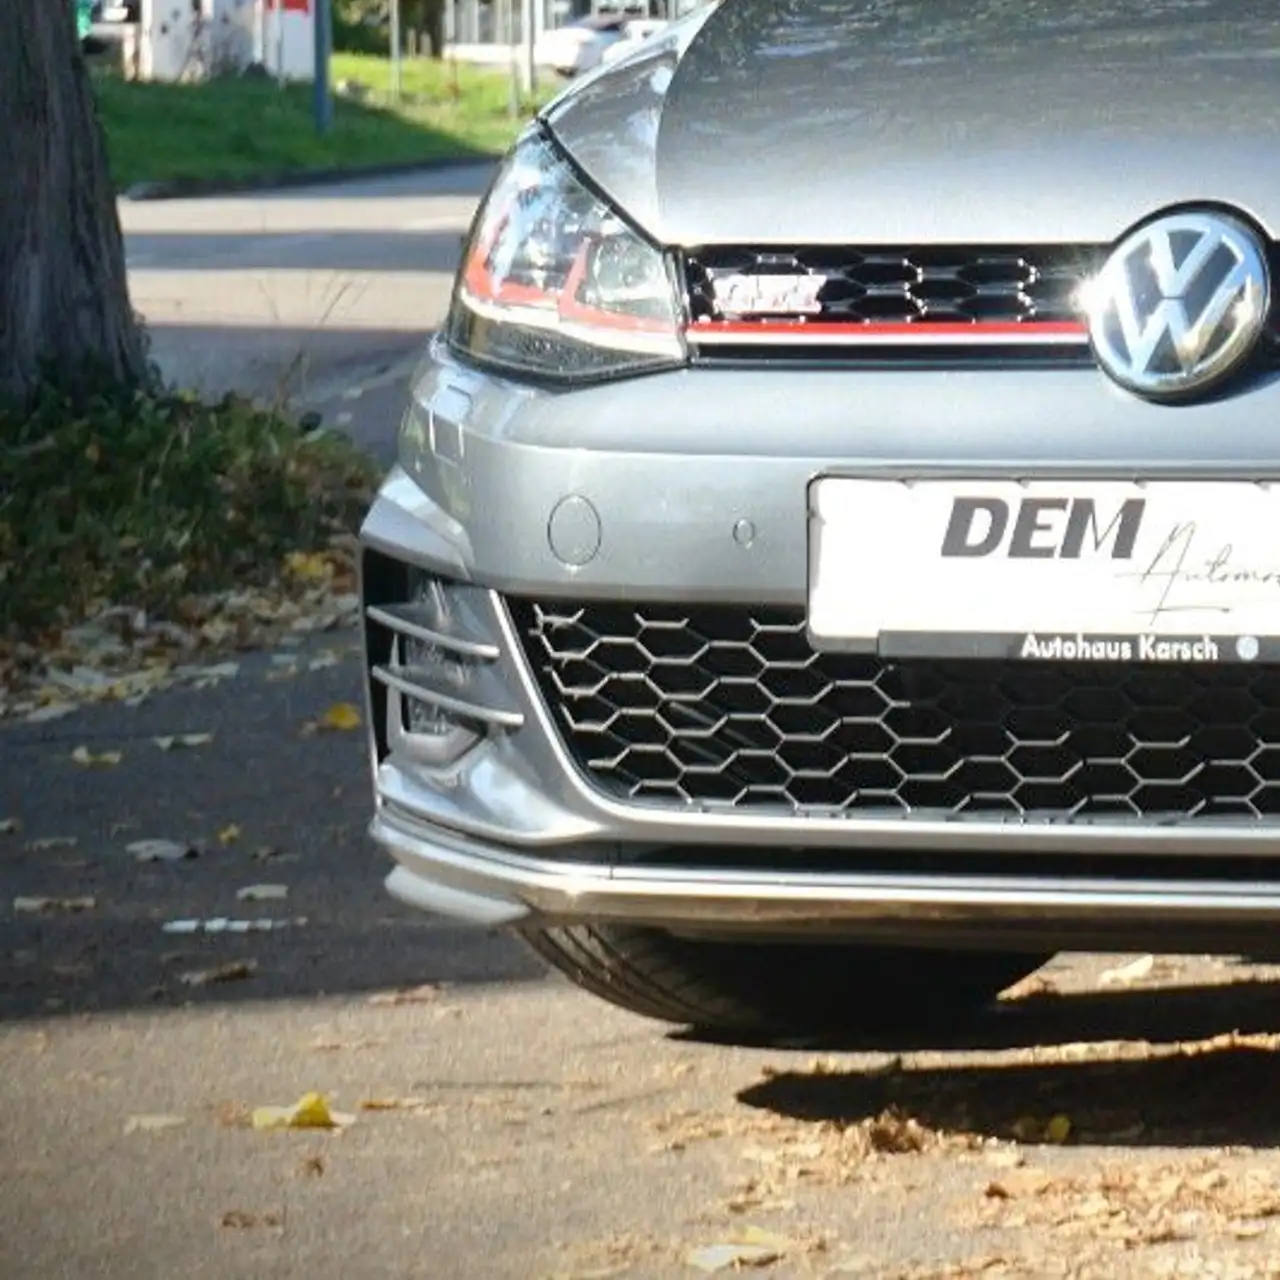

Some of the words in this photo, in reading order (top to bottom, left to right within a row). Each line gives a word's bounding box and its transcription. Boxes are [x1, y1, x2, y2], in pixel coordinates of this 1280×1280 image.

[941, 497, 1146, 559] DEM
[1020, 632, 1132, 661] Autohaus
[1138, 634, 1219, 662] Karsch
